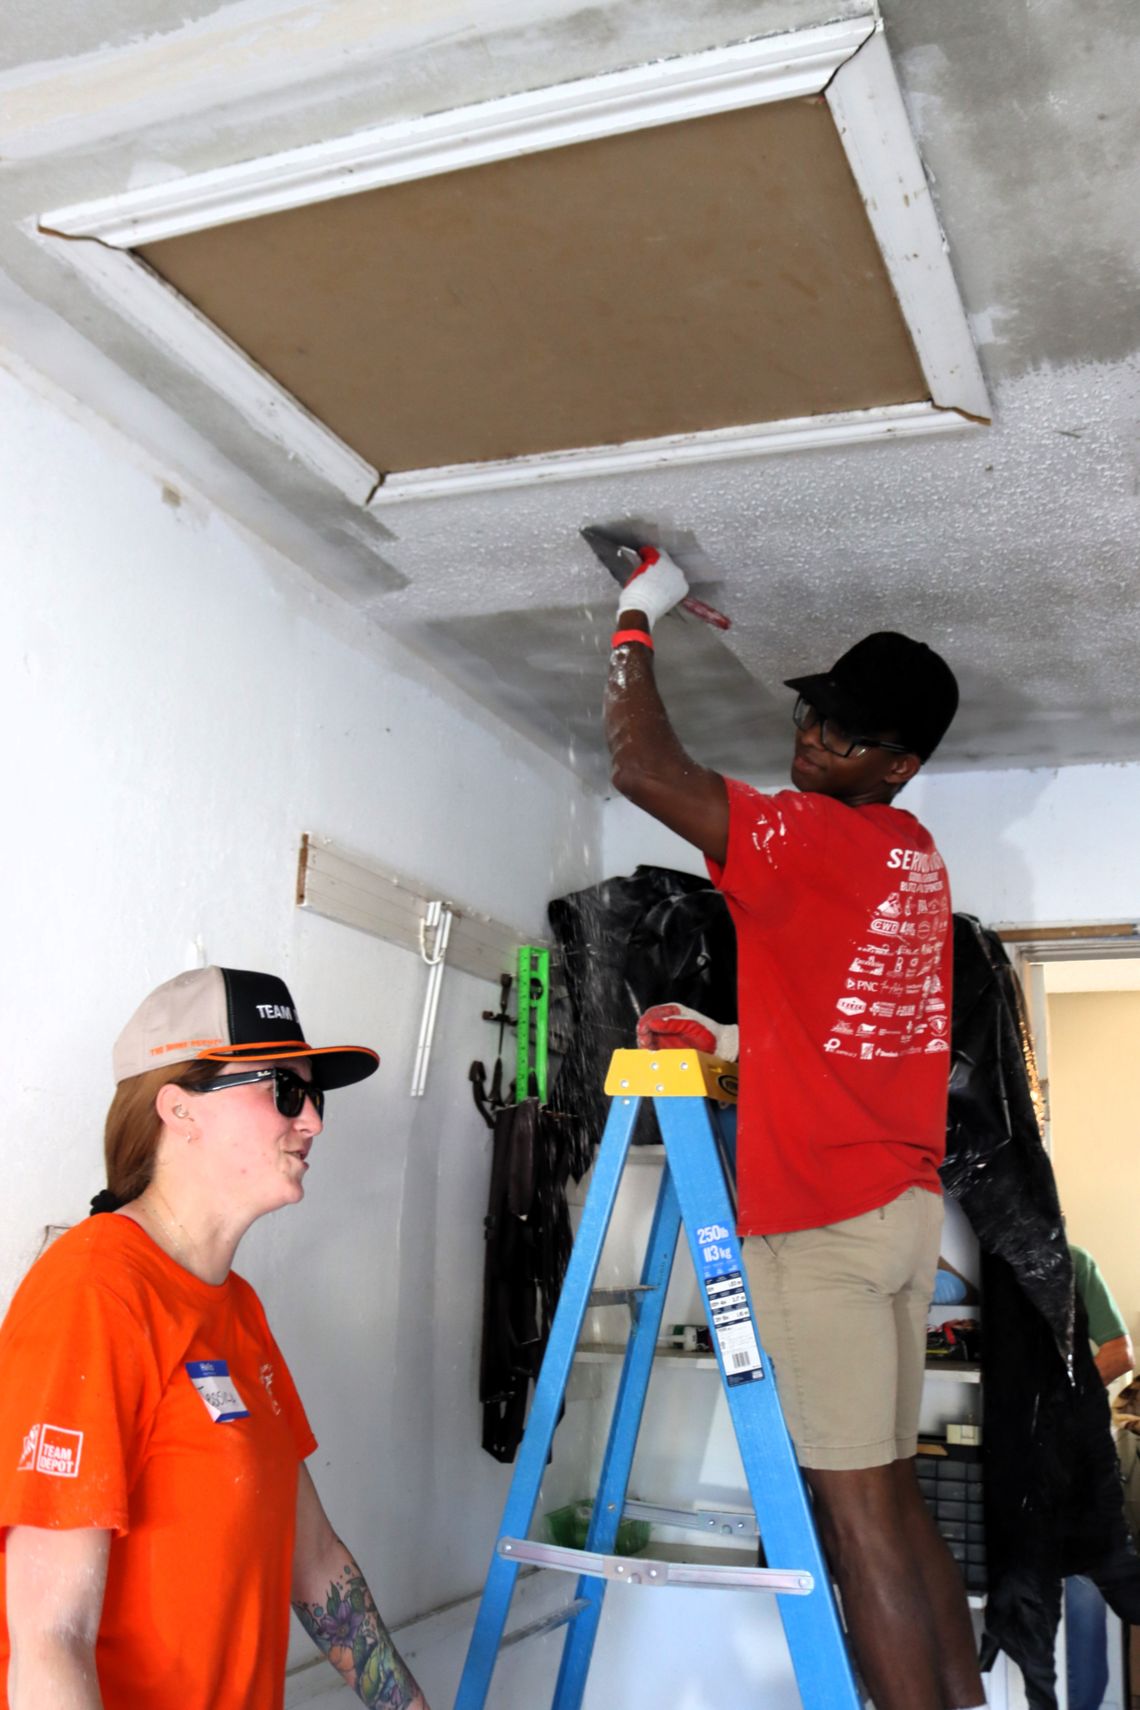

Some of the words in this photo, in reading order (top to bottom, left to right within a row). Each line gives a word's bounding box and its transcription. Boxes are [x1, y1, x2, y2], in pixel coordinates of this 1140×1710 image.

[857, 980, 878, 992] PNC
[256, 1004, 293, 1020] TEAM
[43, 1443, 72, 1460] TEAM
[40, 1456, 74, 1473] DEPOT
